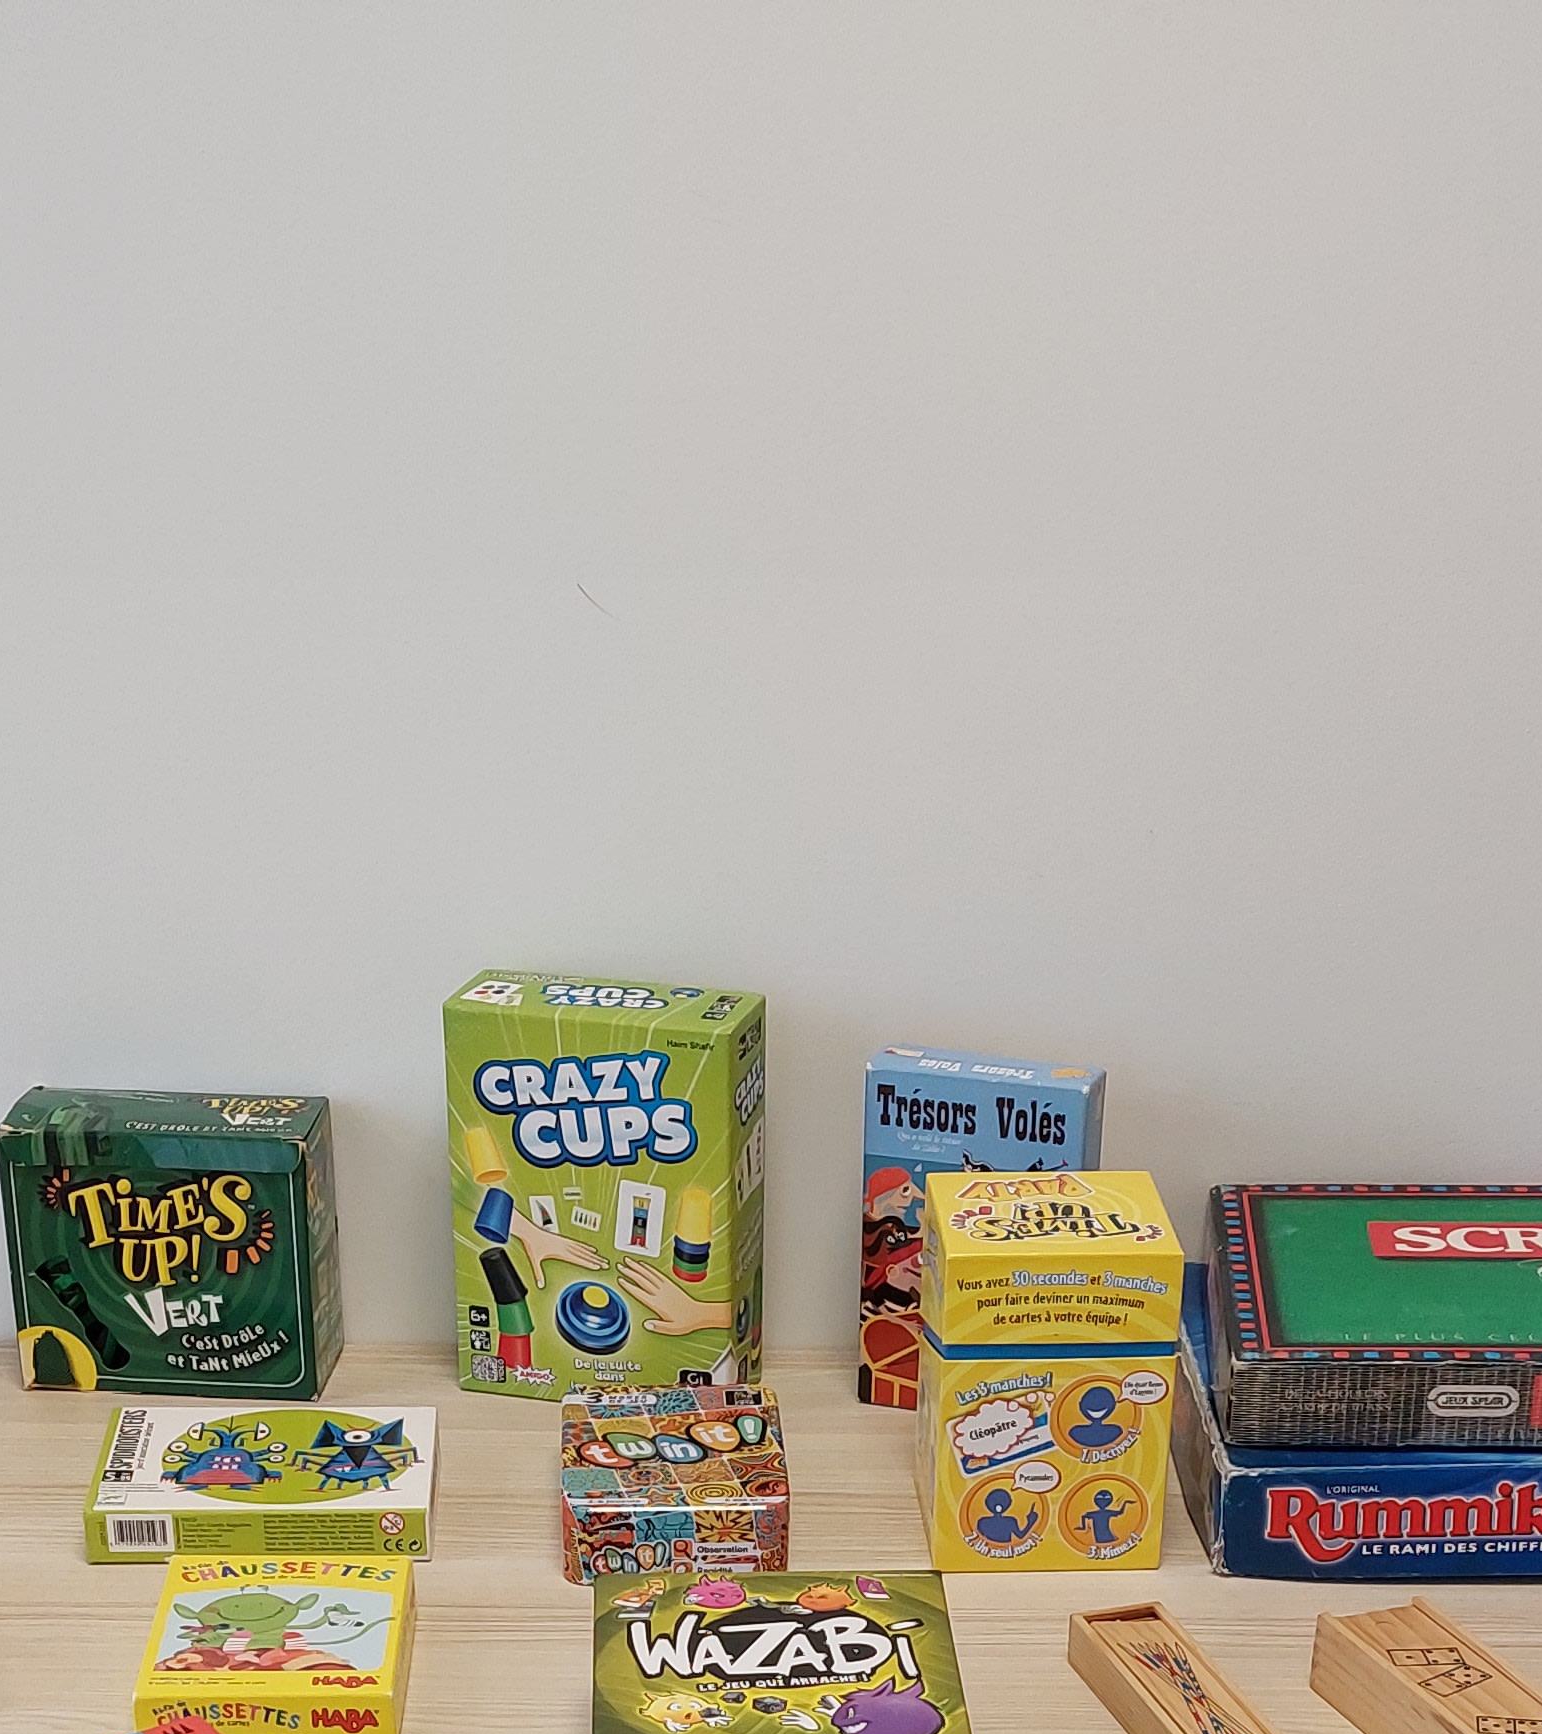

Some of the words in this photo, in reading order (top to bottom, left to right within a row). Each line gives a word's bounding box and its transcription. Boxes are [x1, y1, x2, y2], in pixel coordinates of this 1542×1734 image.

[479, 1055, 662, 1106] CRAZY
[876, 1083, 978, 1136] Trésors
[995, 1096, 1068, 1147] Volés
[519, 1103, 691, 1160] CUPS
[119, 1234, 203, 1288] UP!
[956, 1278, 983, 1292] Vous
[985, 1277, 1011, 1289] avez
[1011, 1270, 1030, 1287] 30
[1030, 1270, 1089, 1286] secondes
[1090, 1274, 1102, 1285] et
[1102, 1270, 1114, 1286] 3
[1113, 1274, 1169, 1296] manches
[976, 1298, 1003, 1313] pour
[1004, 1292, 1030, 1306] faire
[1032, 1291, 1074, 1306] deviner
[1075, 1295, 1091, 1305] un
[1092, 1294, 1146, 1310] maximum
[992, 1312, 1007, 1326] de
[1008, 1311, 1043, 1324] cartes
[1044, 1310, 1052, 1323] à
[1053, 1312, 1084, 1323] votre
[1085, 1311, 1123, 1328] équipe
[574, 1358, 593, 1371] De
[593, 1357, 609, 1372] la
[608, 1359, 643, 1372] suite
[593, 1371, 627, 1383] dans
[955, 1389, 979, 1406] Les
[977, 1381, 990, 1397] 3
[989, 1372, 1045, 1394] manches
[696, 1545, 749, 1554] Observation
[1361, 1541, 1384, 1555] LE
[1389, 1541, 1438, 1556] RAMI
[1443, 1540, 1478, 1554] DES
[180, 1560, 397, 1583] CHAUSSETTES
[312, 1675, 379, 1689] HABA
[698, 1682, 722, 1693] LE
[722, 1679, 752, 1691] JEU
[754, 1674, 786, 1688] QUI
[789, 1673, 858, 1687] ARRACHE
[310, 1707, 380, 1734] HABA
